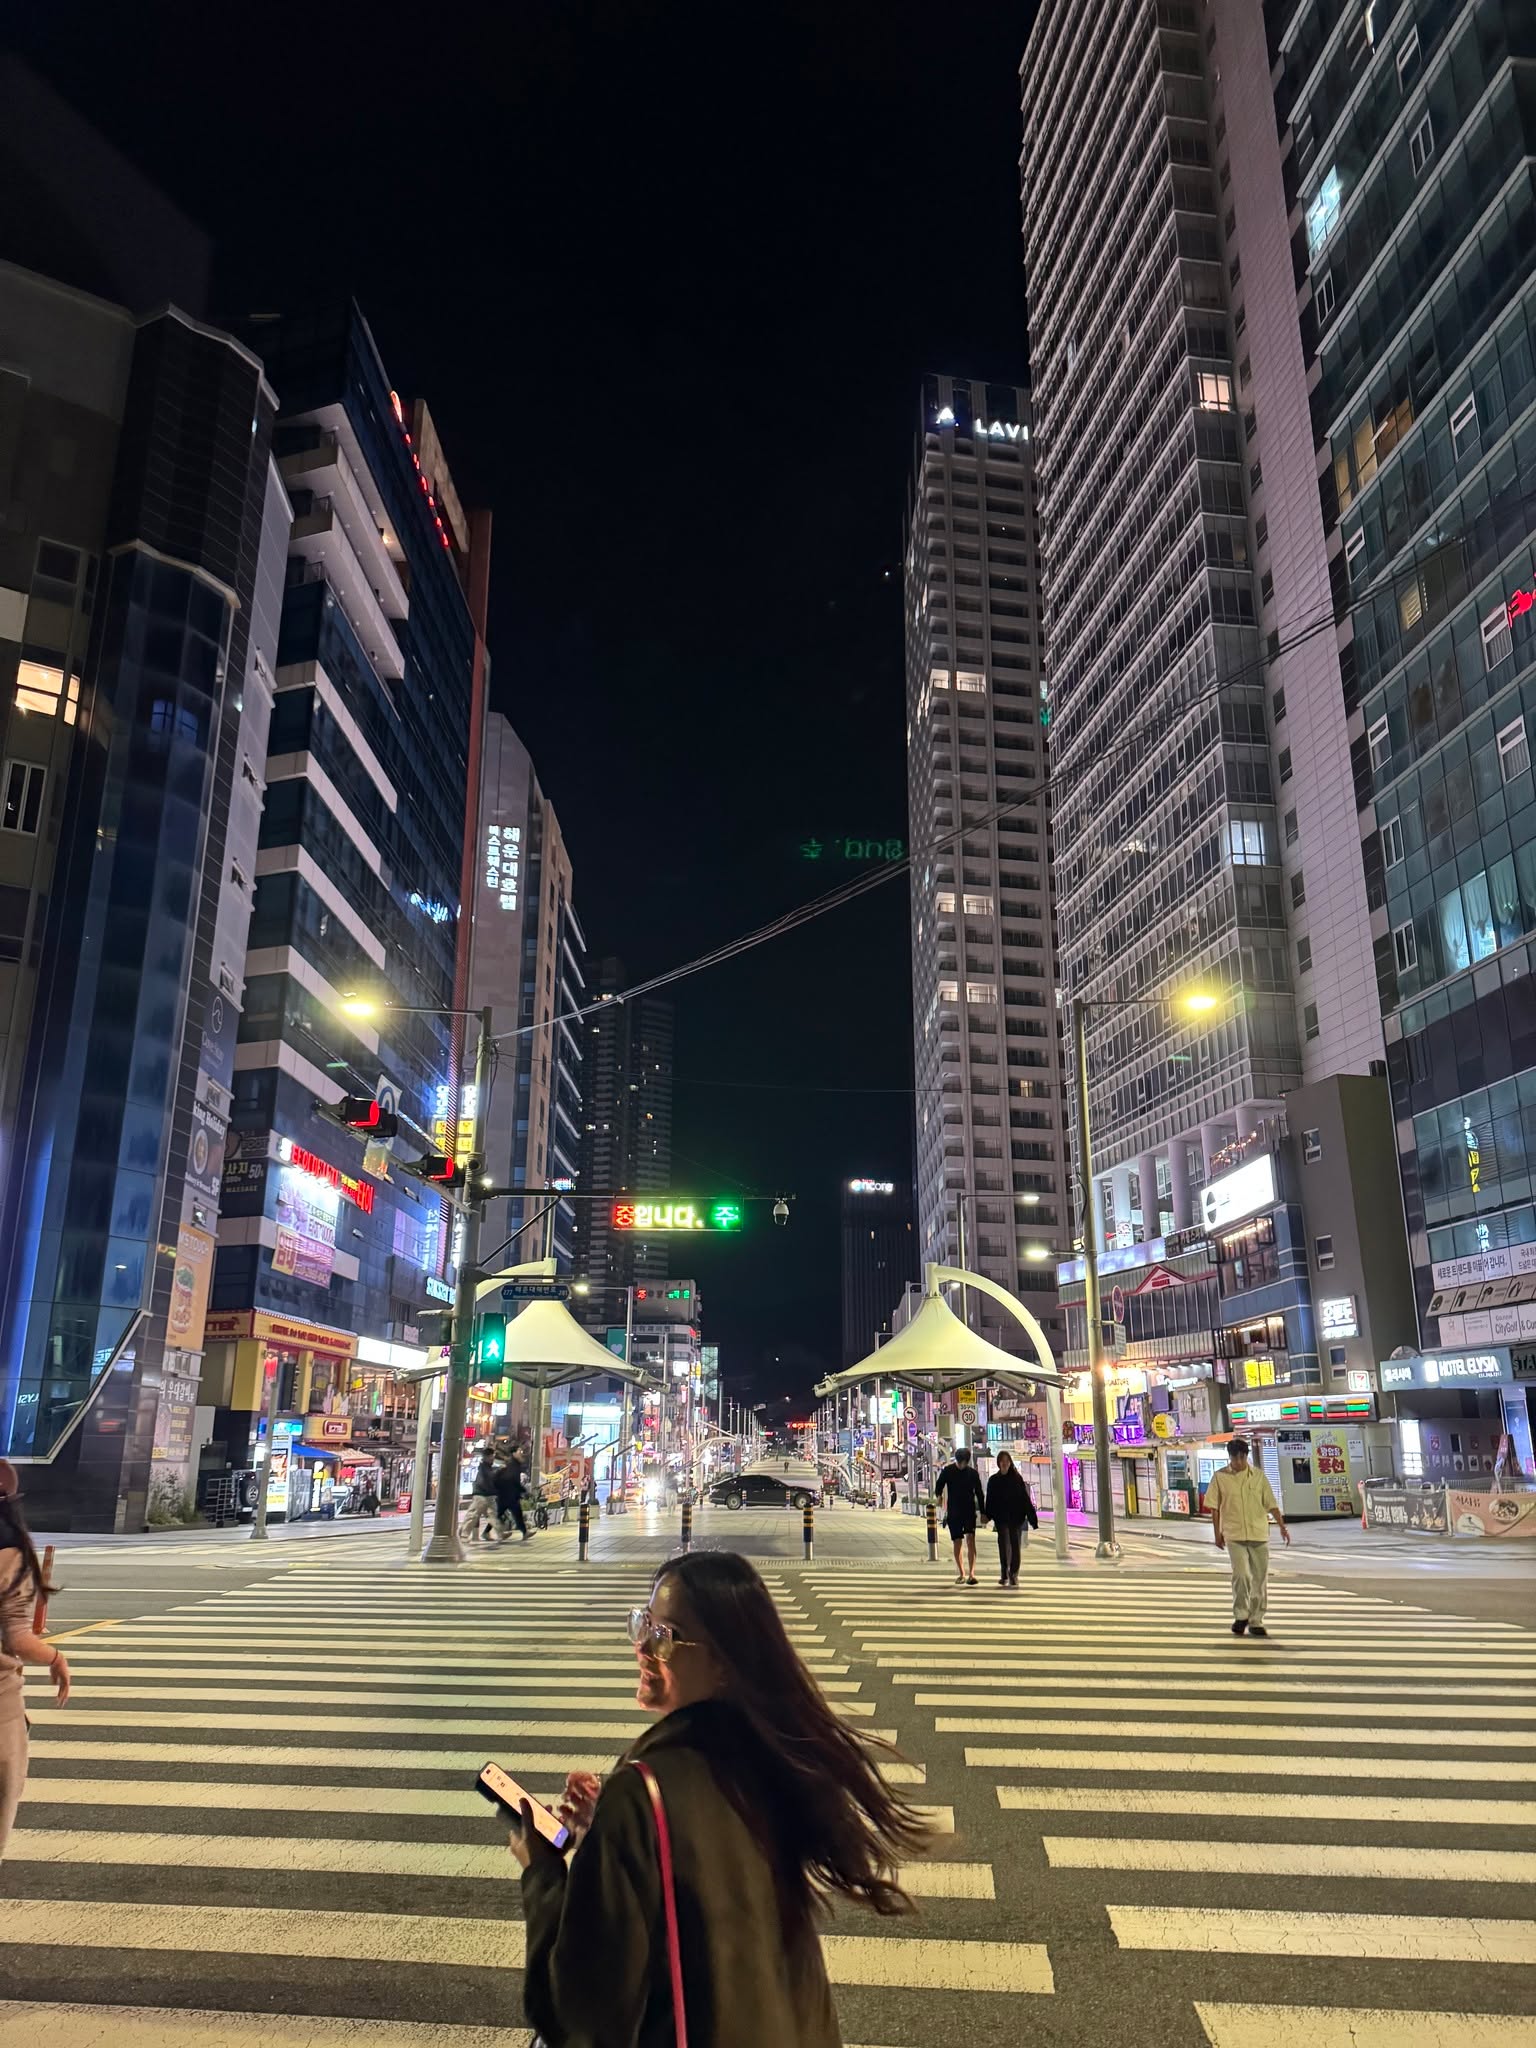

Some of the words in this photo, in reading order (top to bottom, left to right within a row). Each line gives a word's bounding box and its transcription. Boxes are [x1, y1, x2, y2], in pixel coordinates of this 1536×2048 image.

[616, 1204, 705, 1228] 중입니다.
[1437, 1265, 1452, 1280] 새로운
[1451, 1260, 1473, 1277] 트렌드를
[1438, 1359, 1468, 1377] HOTEL
[1467, 1355, 1500, 1375] ELYSIA
[964, 1413, 973, 1422] 30
